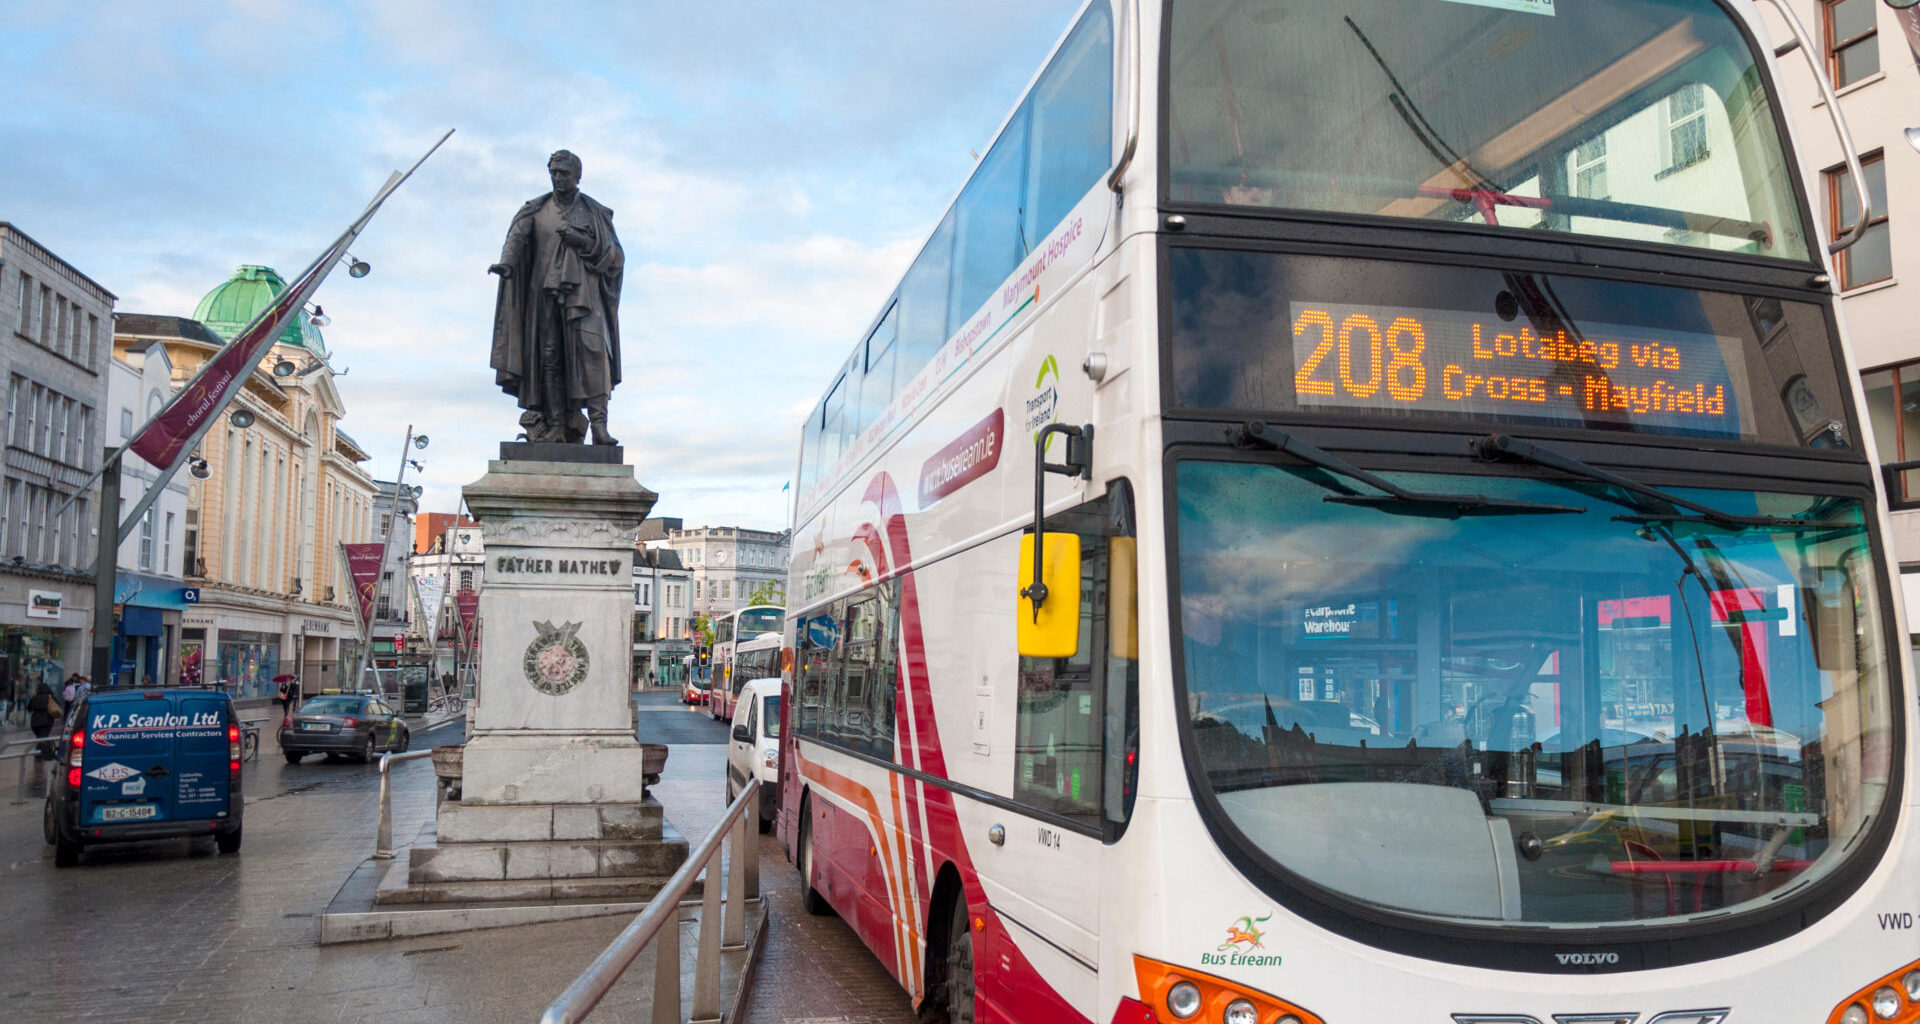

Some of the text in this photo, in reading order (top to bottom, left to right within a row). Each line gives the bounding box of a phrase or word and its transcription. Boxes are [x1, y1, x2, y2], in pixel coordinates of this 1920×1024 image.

[1002, 217, 1083, 310] Marymount Hospice
[1294, 309, 1426, 401] 208
[1472, 323, 1680, 370] Lotabeg via
[186, 370, 233, 427] choral festival
[1443, 364, 1725, 415] Cross - Mayfield
[1026, 387, 1052, 414] Transport
[1032, 408, 1051, 432] Ireland
[497, 557, 622, 576] FATHER MATHEW
[1304, 620, 1357, 633] Warehou
[93, 711, 221, 728] K.P. Scanlon Ltd.
[91, 730, 222, 742] Mechanical Services Contractors
[1038, 827, 1052, 847] VWD
[1878, 912, 1913, 930] VWD
[1201, 951, 1283, 966] Bus Éireann
[1554, 952, 1619, 965] VOLVO
